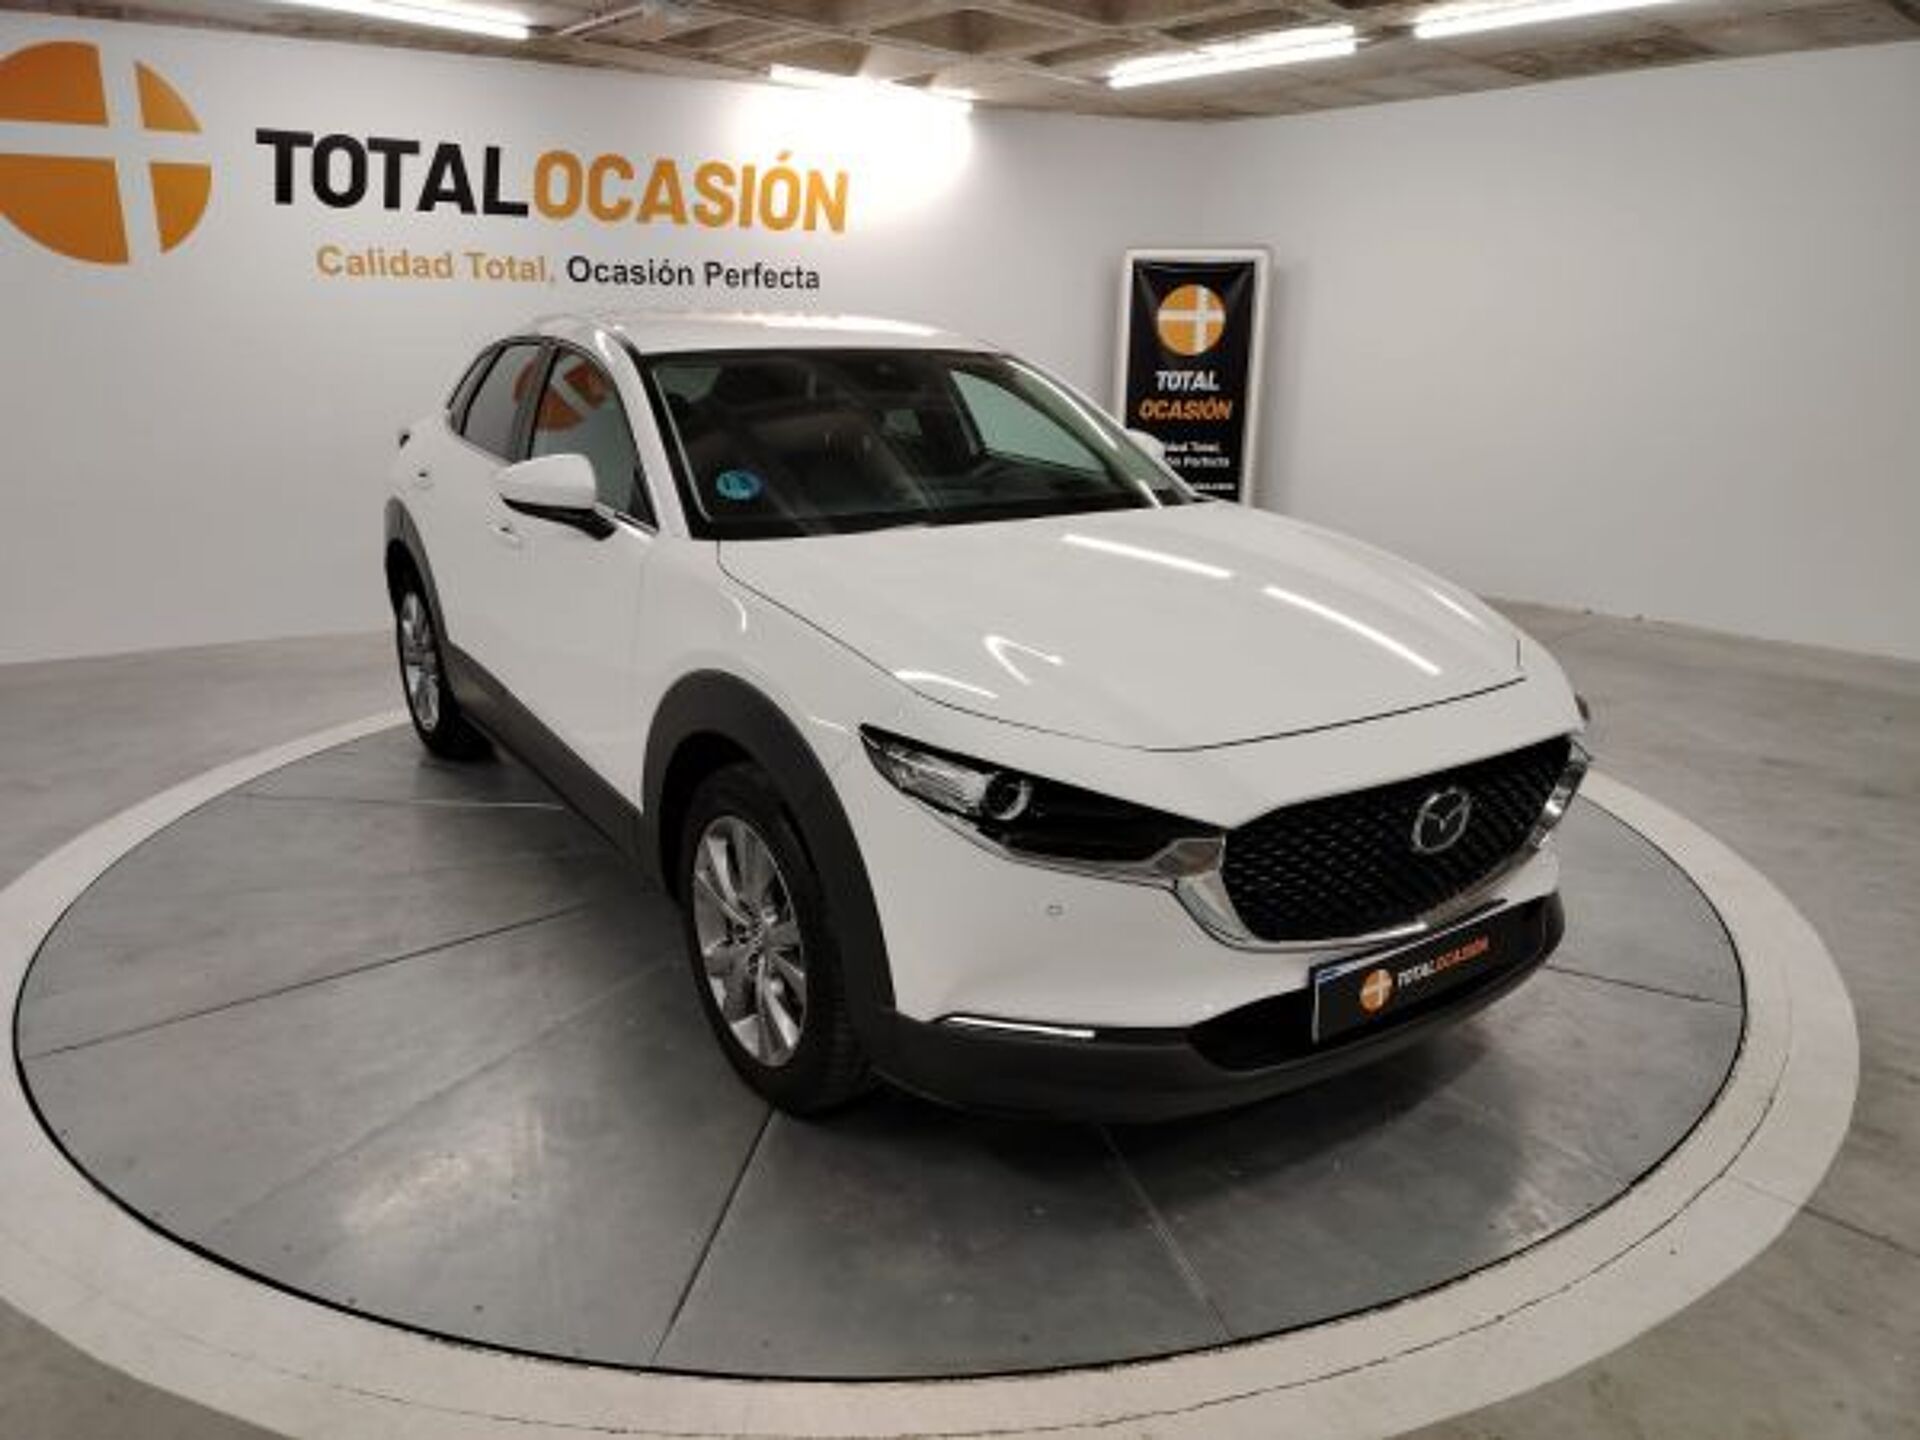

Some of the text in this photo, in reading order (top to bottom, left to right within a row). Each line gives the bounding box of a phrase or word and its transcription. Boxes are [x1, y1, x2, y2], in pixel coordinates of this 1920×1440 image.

[316, 245, 453, 279] Calidad
[567, 255, 694, 286] Ocasión
[704, 261, 820, 290] Perfecta
[1156, 370, 1220, 392] TOTAL
[1138, 397, 1232, 420] OCASIÓN
